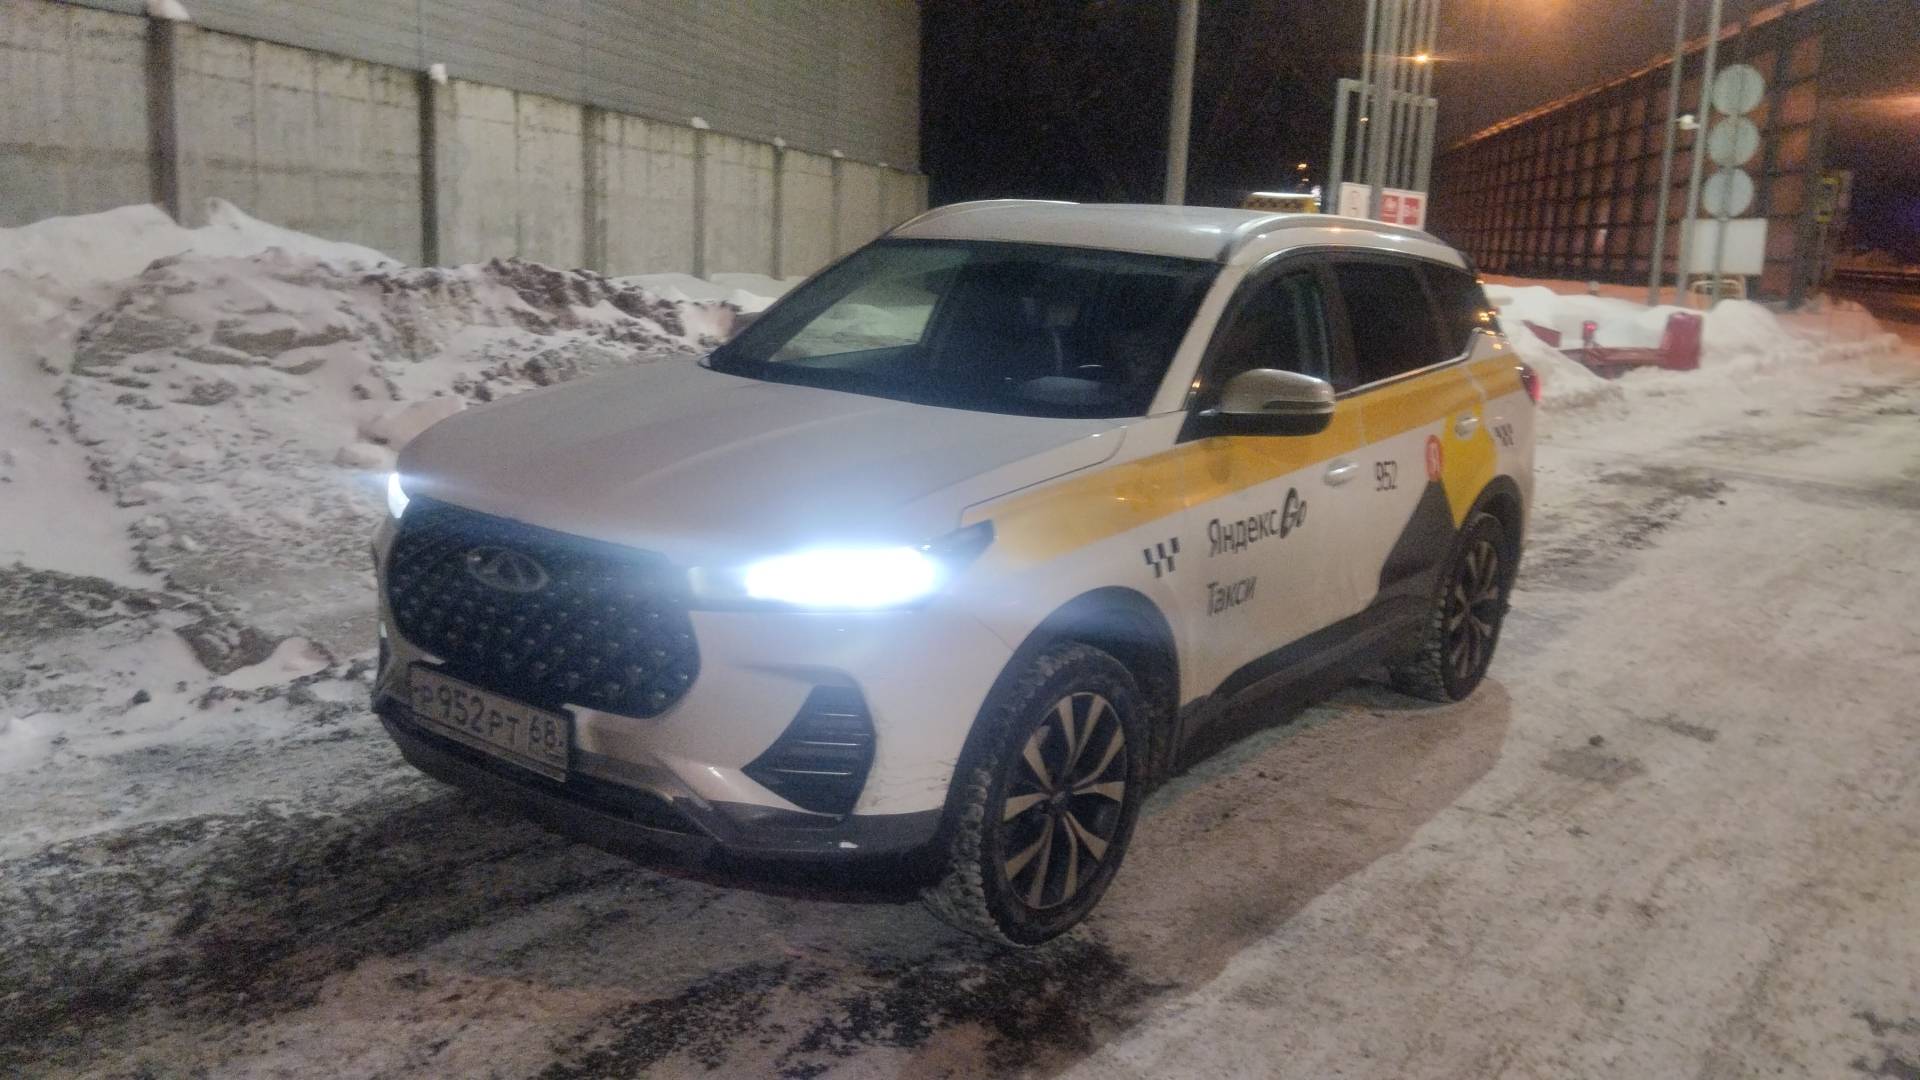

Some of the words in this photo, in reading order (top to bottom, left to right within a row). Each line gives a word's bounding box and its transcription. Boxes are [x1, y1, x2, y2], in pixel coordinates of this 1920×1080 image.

[1375, 459, 1399, 492] 952
[1207, 508, 1281, 558] Яндекс
[1206, 576, 1257, 616] Такси
[529, 714, 559, 750] 68
